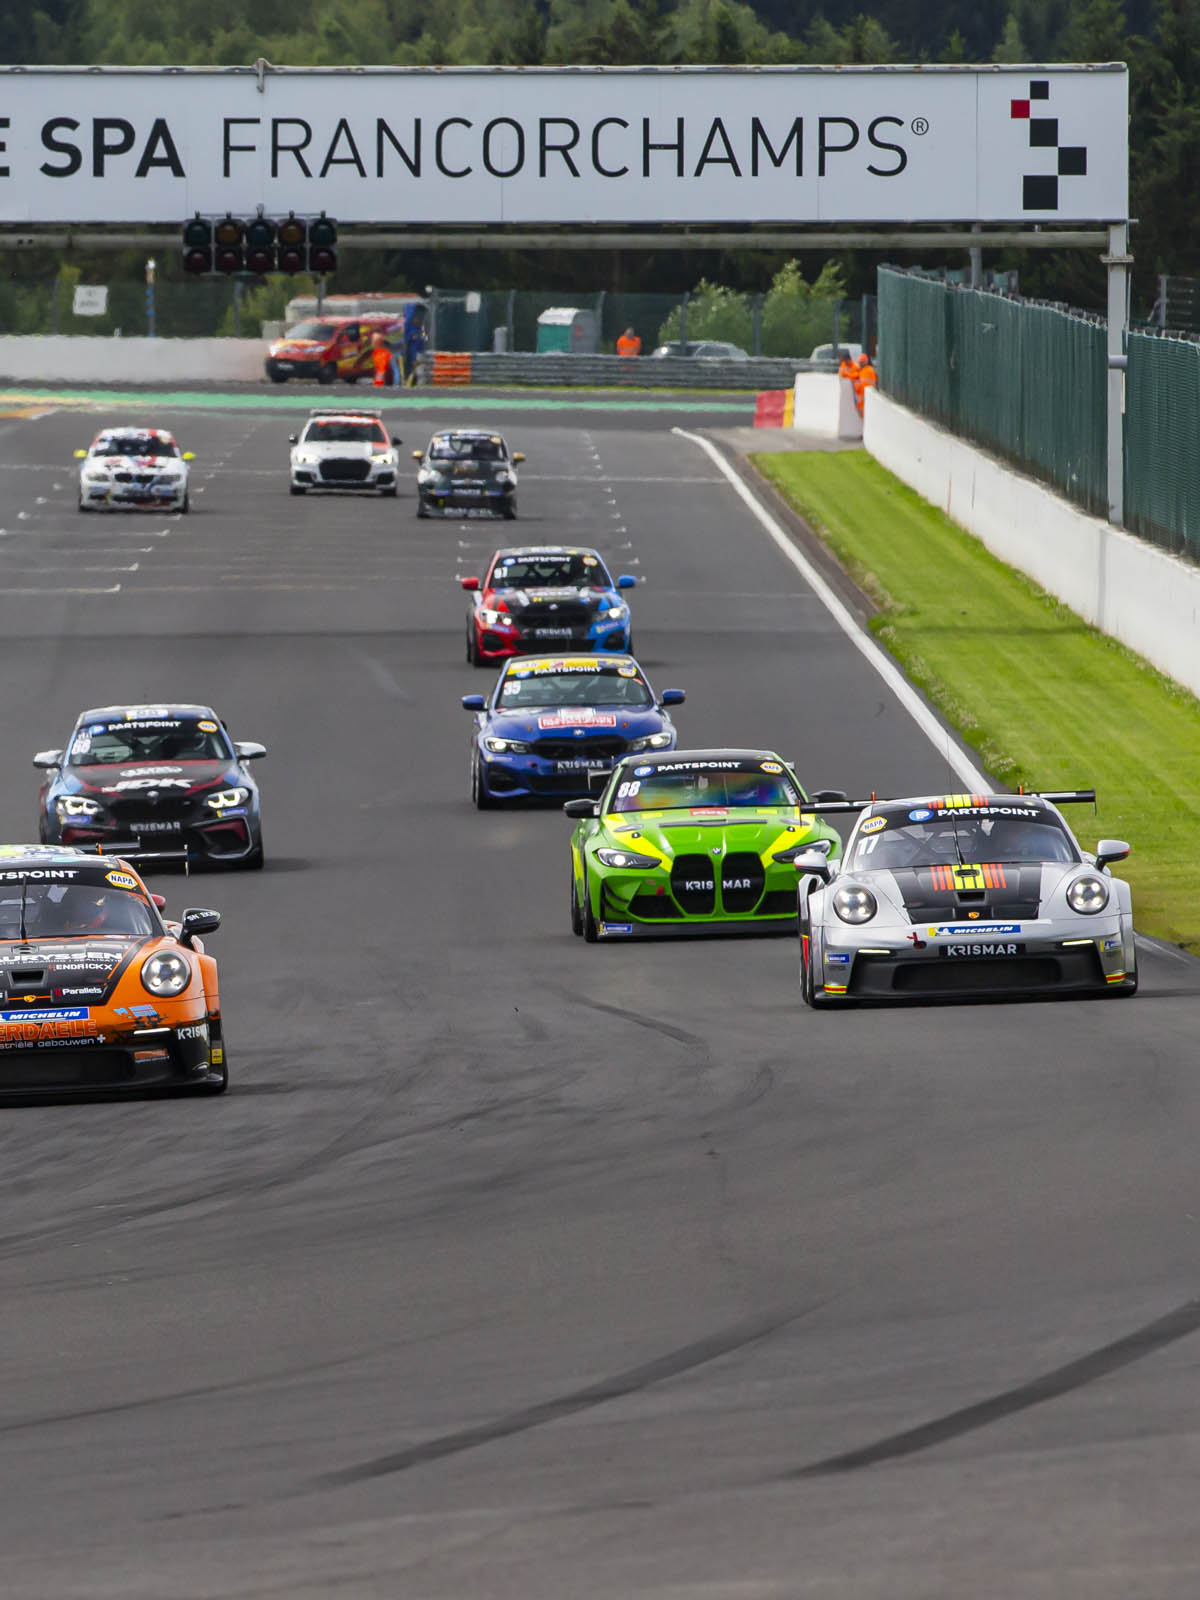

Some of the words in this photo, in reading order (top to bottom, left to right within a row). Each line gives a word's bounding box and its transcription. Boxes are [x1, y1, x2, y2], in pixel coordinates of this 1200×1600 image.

[39, 116, 185, 179] SPA
[534, 666, 602, 675] PARTSPOINT
[107, 721, 181, 731] PARTSPOINT
[557, 760, 603, 769] KRISMAR
[657, 761, 741, 772] PARTSPOINT
[617, 781, 641, 798] 88
[937, 807, 1041, 818] PARTSPOINT
[863, 819, 885, 832] NAPA
[857, 834, 880, 857] 17
[109, 874, 135, 887] NAPA
[953, 925, 1014, 934] MICHELIN
[947, 943, 1017, 957] KRISMAR
[48, 963, 113, 971] HENDRICKX
[62, 986, 102, 996] Parallels
[9, 1010, 81, 1021] MICHELIN
[37, 1037, 95, 1048] gebouwen
